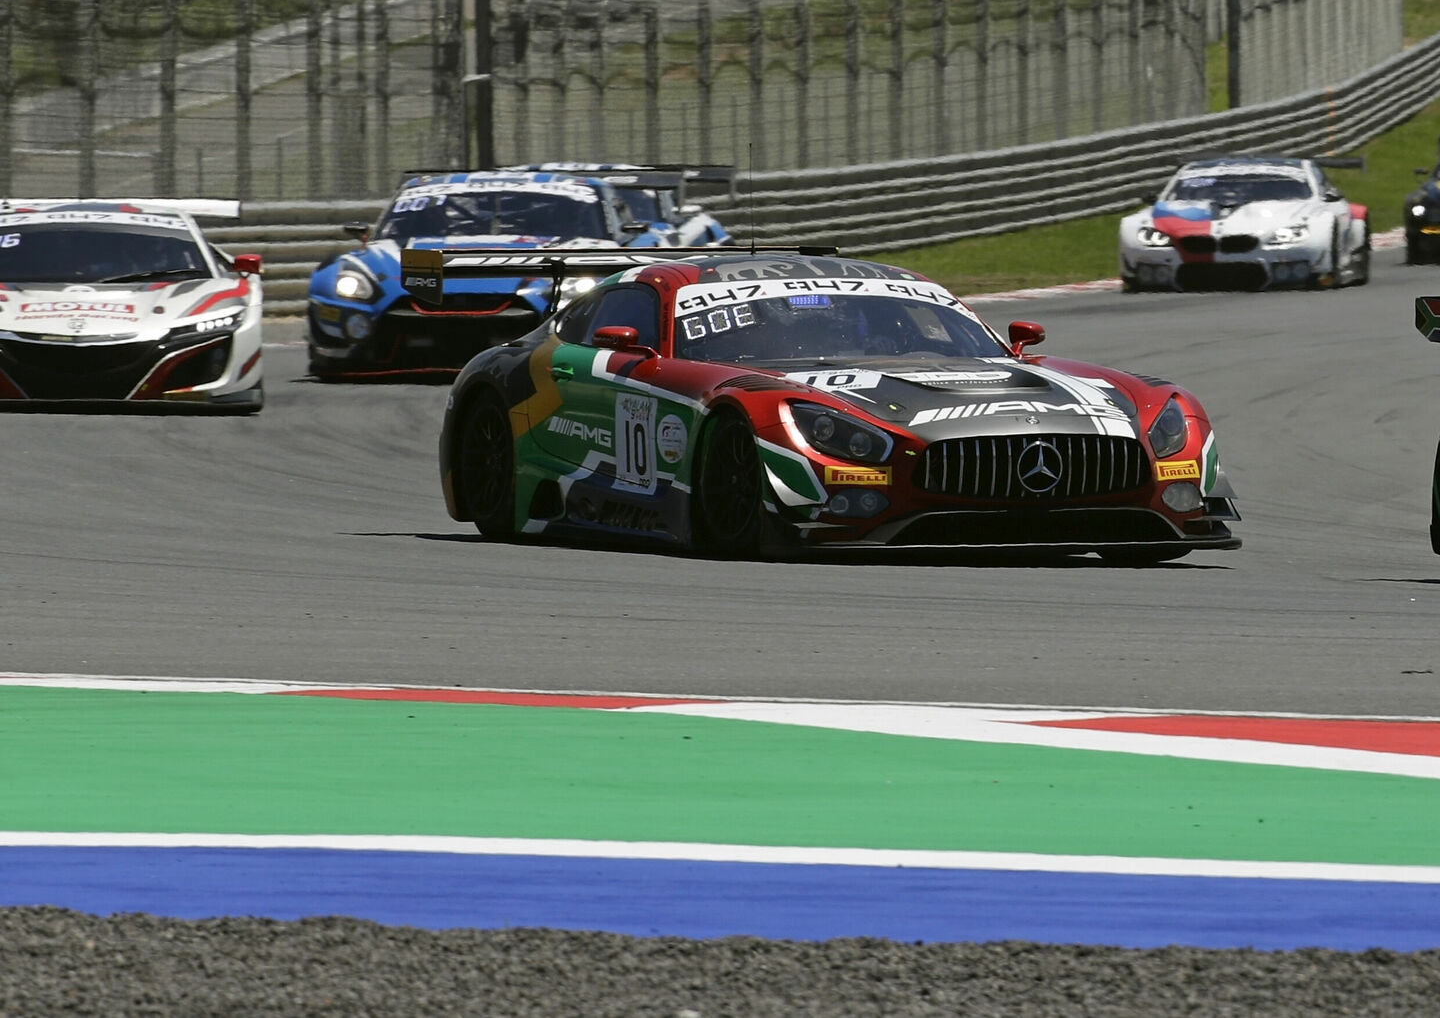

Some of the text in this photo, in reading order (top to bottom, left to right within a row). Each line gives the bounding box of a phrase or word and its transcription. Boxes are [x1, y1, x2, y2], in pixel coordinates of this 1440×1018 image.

[783, 280, 865, 293] 947
[678, 284, 763, 311] 947
[884, 283, 959, 308] 947
[24, 302, 132, 313] MOTUL
[806, 374, 857, 387] 10
[625, 420, 647, 476] 10
[831, 469, 887, 482] PIRELLI
[1159, 463, 1196, 478] PIRELLI
